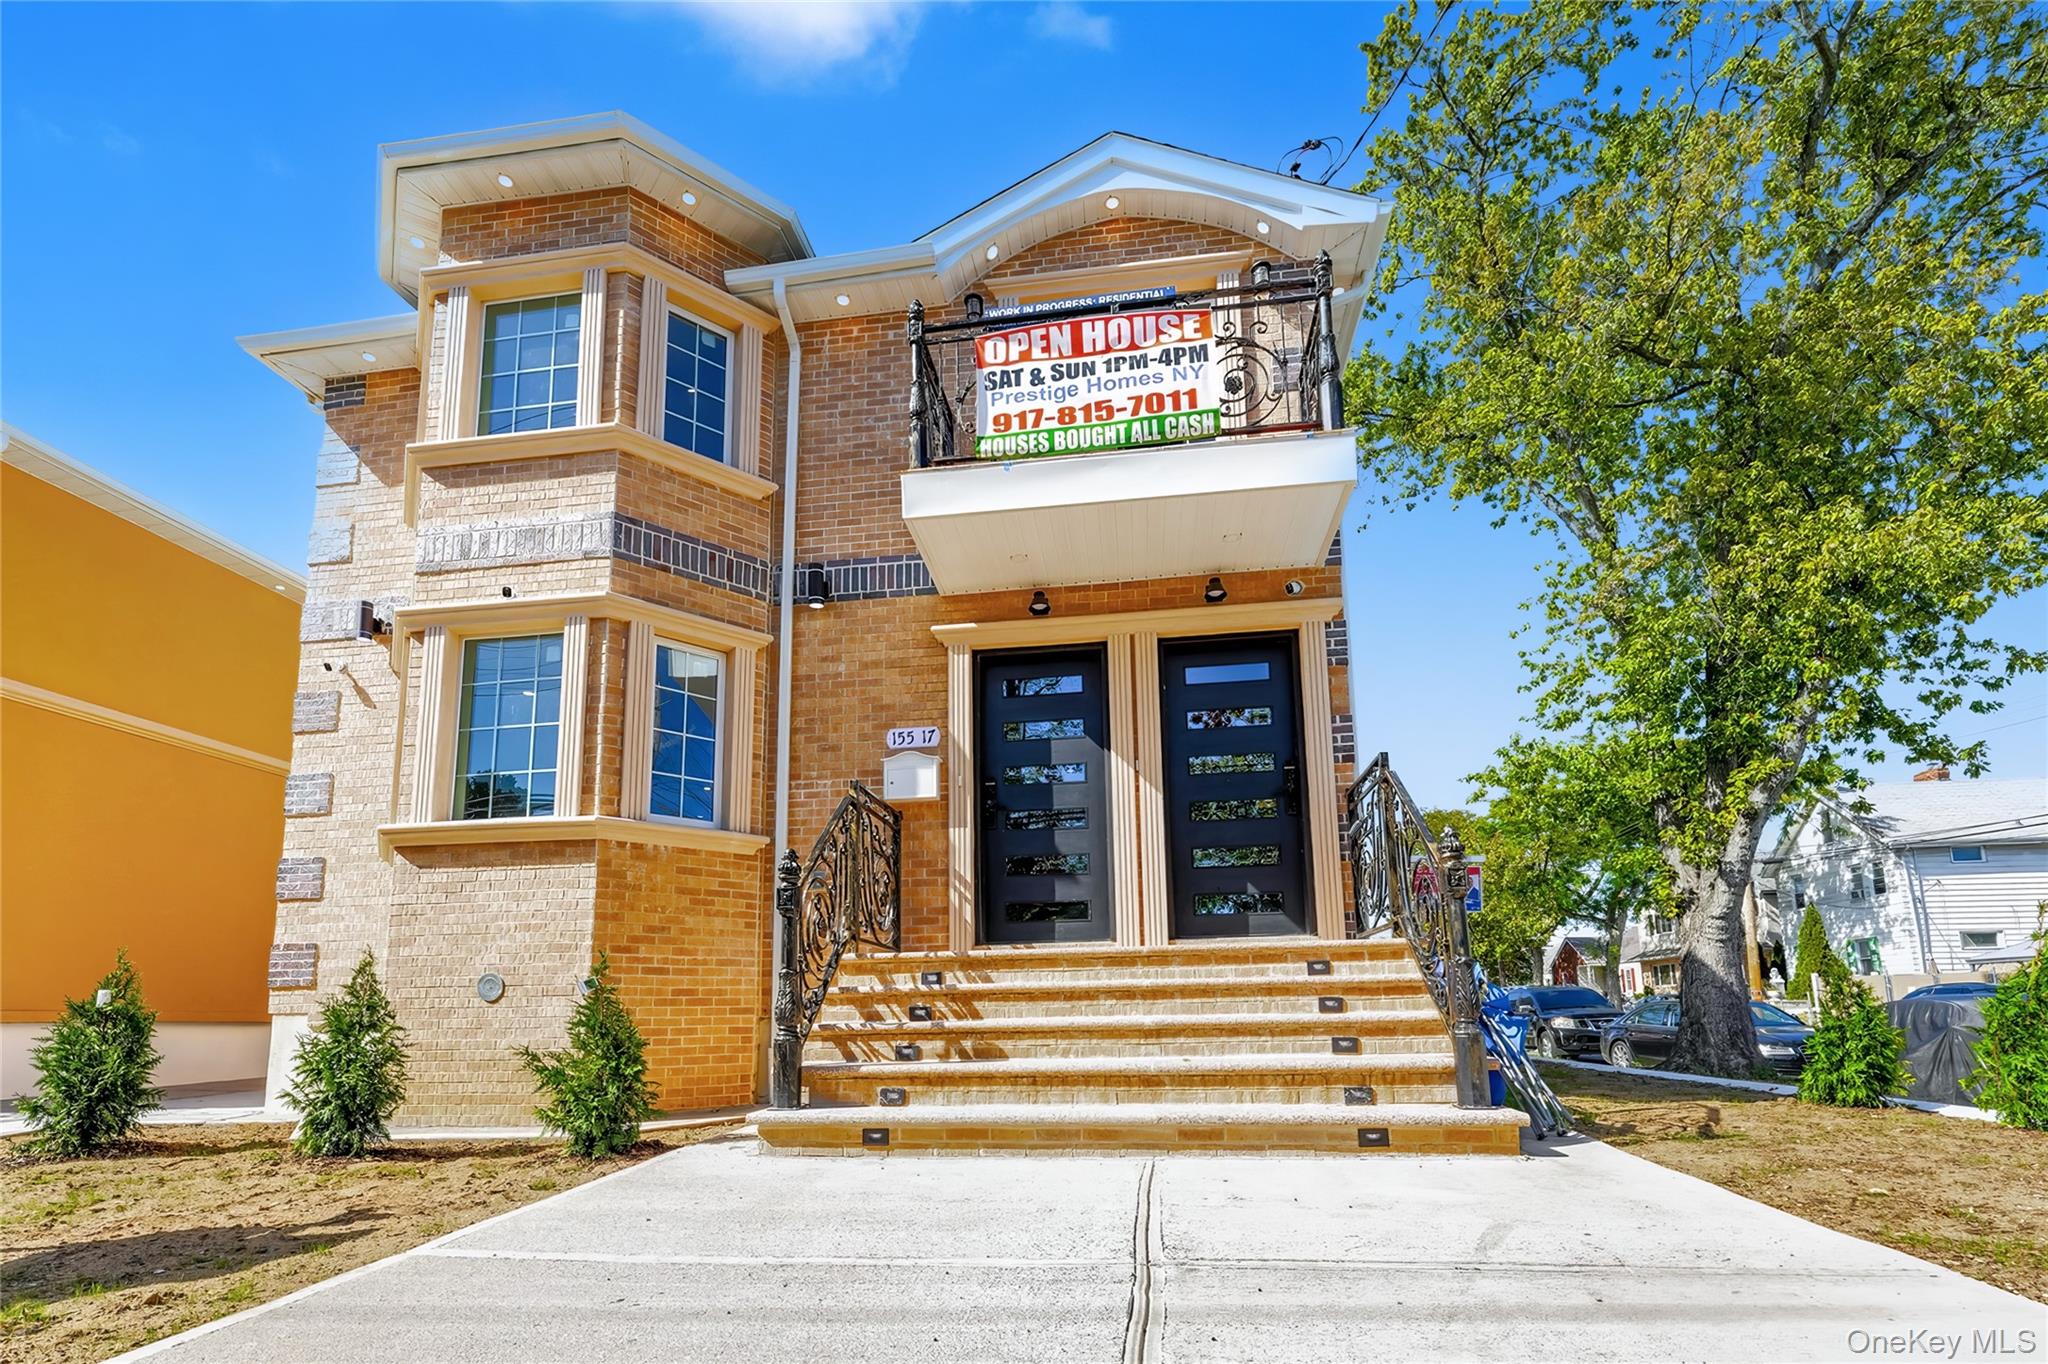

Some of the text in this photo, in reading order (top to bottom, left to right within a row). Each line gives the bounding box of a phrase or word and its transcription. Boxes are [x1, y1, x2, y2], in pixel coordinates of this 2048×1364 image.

[983, 313, 1201, 365] OPEN HOUSE
[984, 343, 1210, 392] SAT & SUN 1PM-4PM
[990, 364, 1205, 407] Prestige Homes NY
[992, 388, 1198, 433] 917-815-7011
[980, 412, 1215, 457] HOUSES BOUGHT ALL CASH
[892, 729, 936, 746] 155 17
